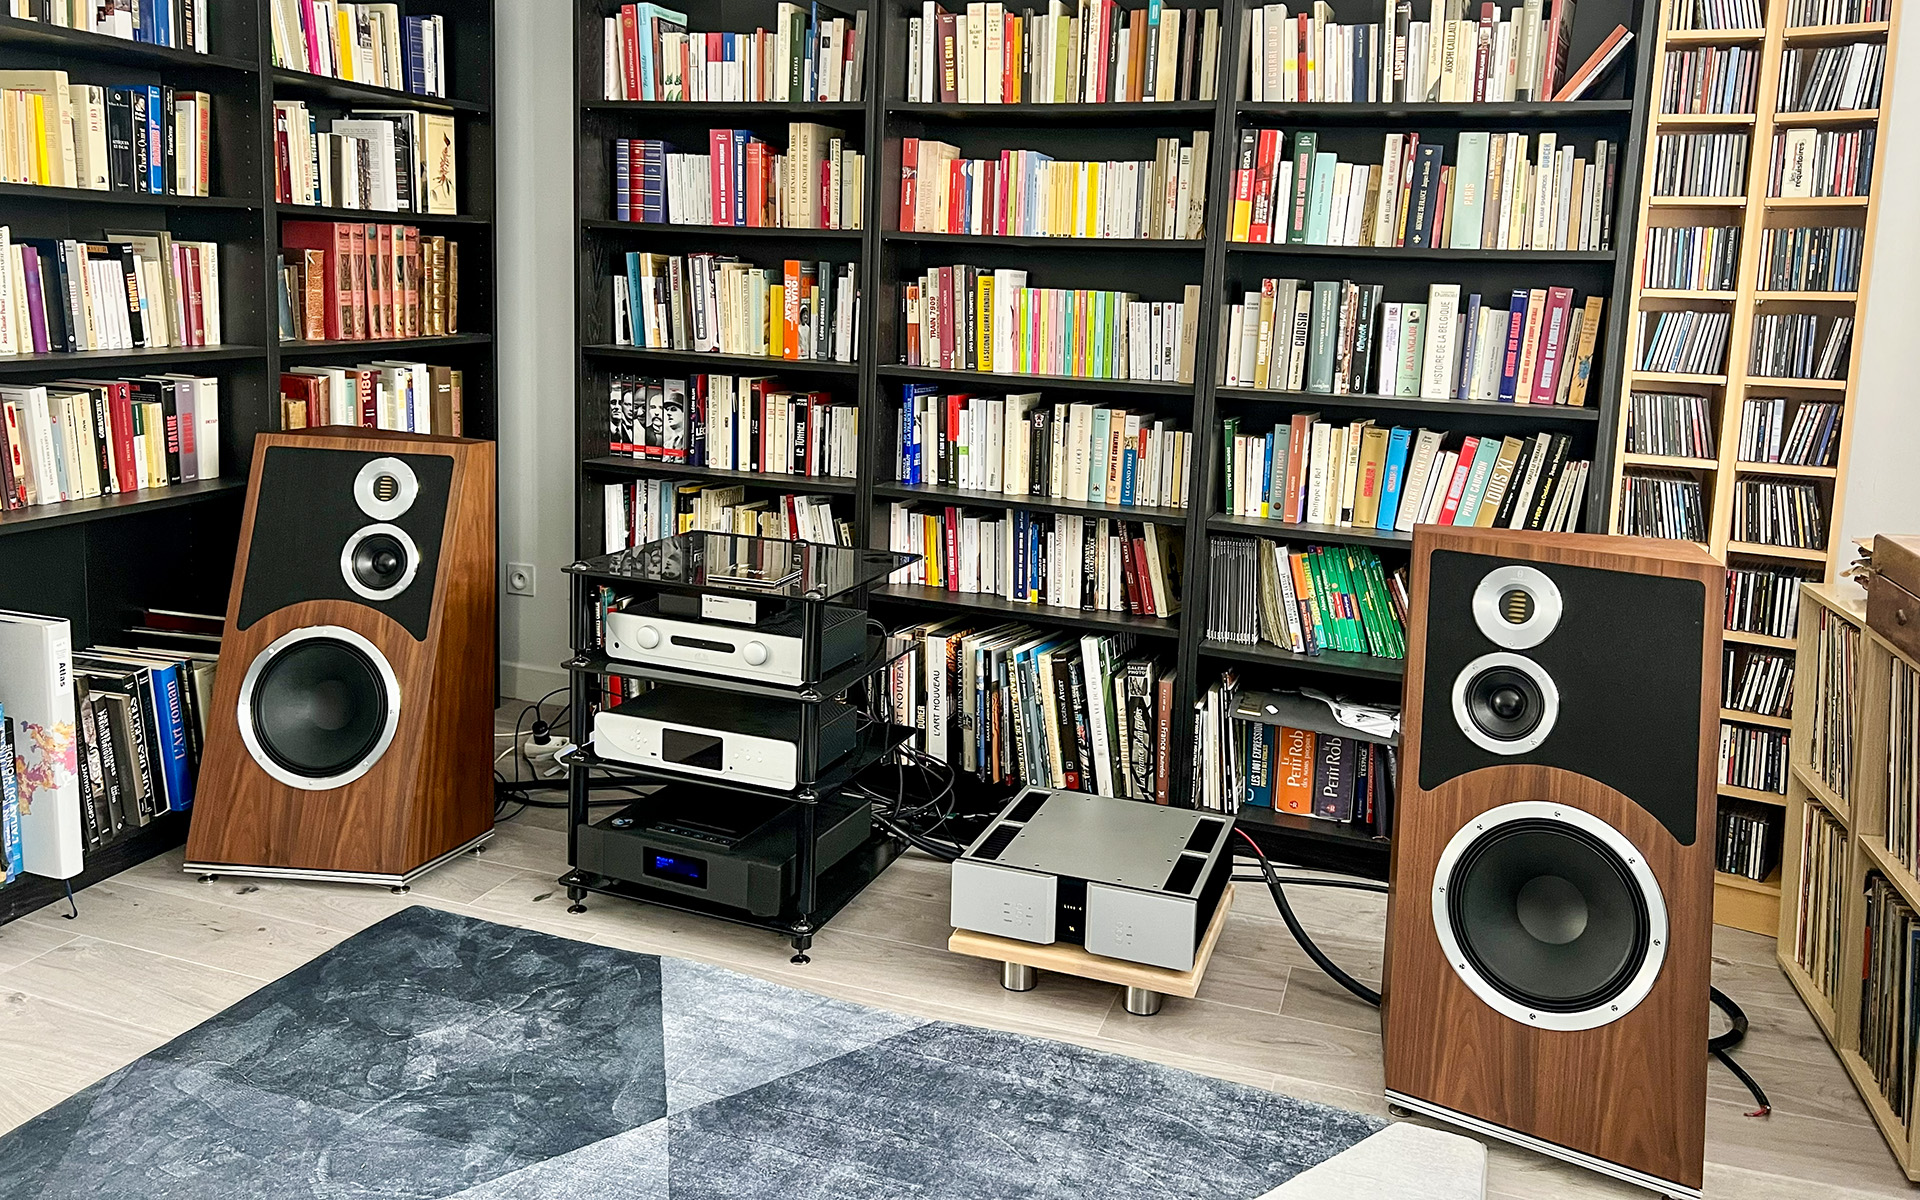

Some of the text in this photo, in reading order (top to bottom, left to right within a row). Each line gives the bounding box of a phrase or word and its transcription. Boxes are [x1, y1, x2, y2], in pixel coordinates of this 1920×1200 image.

[944, 36, 953, 59] GRAND
[1269, 26, 1277, 88] LA GUERRE DE 70
[1394, 36, 1406, 80] RASPOUTINE
[1444, 22, 1457, 73] JOSEPH CAILLAUX
[946, 68, 955, 91] PIERRE
[137, 128, 147, 172] Charles Quint
[791, 154, 796, 162] DE
[802, 154, 807, 162] DE
[1795, 142, 1805, 187] réquisitoires
[1240, 150, 1252, 198] URBEX RDA
[1464, 183, 1474, 206] PARIS
[1540, 174, 1548, 206] SHAWCROSS
[126, 272, 140, 313] CROMWELL
[1294, 312, 1308, 346] CHOISIR
[1433, 302, 1450, 384] HISTOIRE DE LA BELGIQUE
[1405, 326, 1417, 371] JEAN ANGLADE
[362, 370, 371, 403] 1180
[95, 399, 104, 438] GORBATCHEV
[167, 415, 179, 454] STALINE
[795, 422, 805, 456] LE TUNNEL
[1420, 444, 1431, 458] ANS
[1275, 475, 1283, 490] PAPES
[1313, 468, 1322, 478] Bel
[1414, 459, 1427, 476] CENT
[1485, 458, 1514, 505] LOUIS XI
[1525, 468, 1535, 485] CHARLES
[1311, 488, 1323, 517] Philippe
[1405, 488, 1416, 513] GUERRE
[1462, 461, 1488, 516] PIERRE CAUCHON
[1534, 506, 1543, 519] PEUR
[1539, 478, 1552, 500] Occident
[1548, 464, 1557, 476] Jean
[1402, 513, 1412, 522] LA
[1281, 573, 1289, 592] LESSIVE
[1302, 562, 1322, 626] POITOU-CHARENTES
[1316, 575, 1327, 611] Alsace Lorraine
[1321, 570, 1335, 619] Champagne Ardenne
[1286, 600, 1295, 624] FABRIQUER
[896, 660, 904, 710] NOUVEAU
[958, 675, 963, 687] DU
[1092, 692, 1098, 700] DU
[166, 680, 186, 760] L'Art roman
[916, 706, 926, 729] DÜRER
[1060, 702, 1068, 725] EUGÈNE
[1097, 738, 1103, 747] LA
[1134, 707, 1146, 788] La France d'autrefois
[1160, 727, 1168, 750] France
[81, 764, 90, 793] CHAUVET
[87, 742, 104, 792] LASCAUX
[1251, 774, 1261, 786] LES
[1252, 760, 1261, 774] 1001
[5, 744, 19, 844] L'ATLAS DU MONDE
[85, 794, 95, 818] GROTTE
[90, 819, 96, 829] LA
